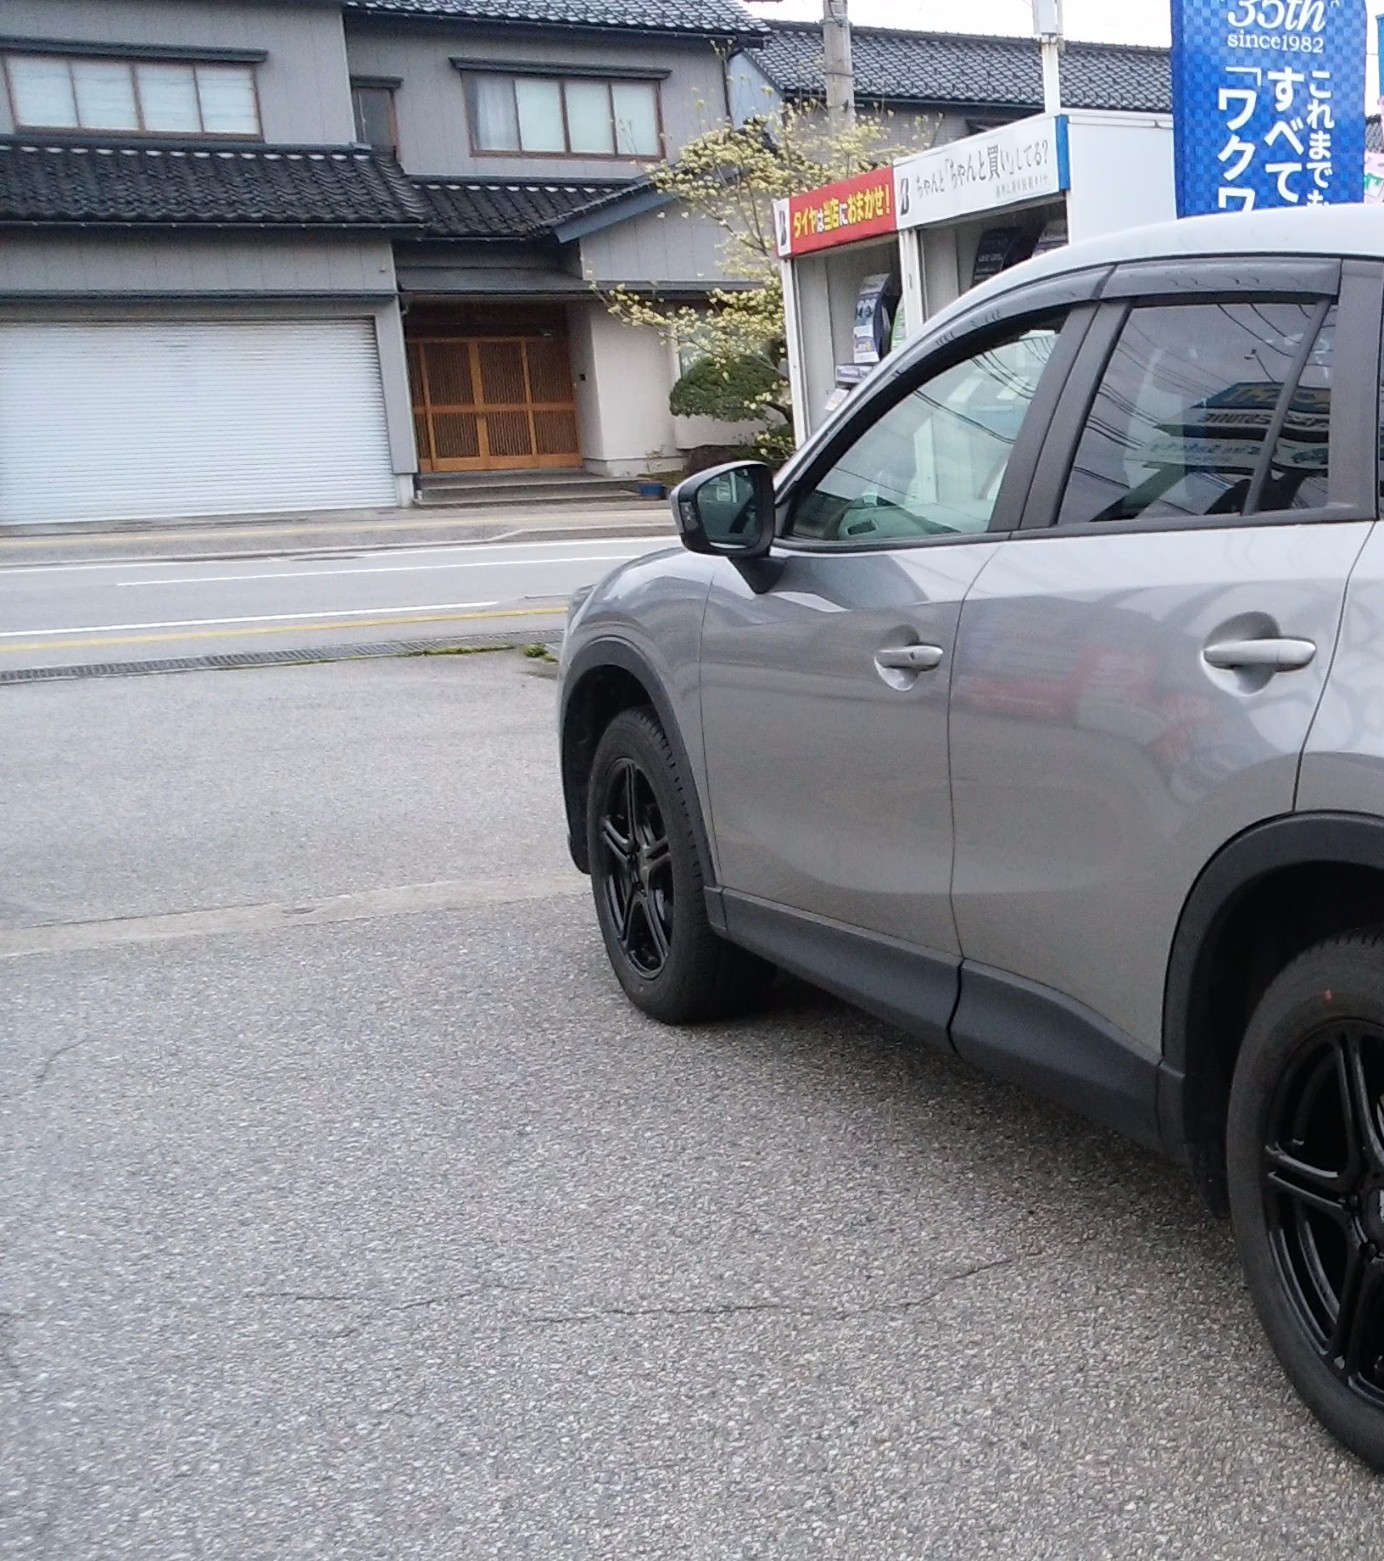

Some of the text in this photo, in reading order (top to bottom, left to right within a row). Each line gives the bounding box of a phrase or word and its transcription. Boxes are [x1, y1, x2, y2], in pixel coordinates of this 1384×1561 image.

[1227, 31, 1324, 53] since1982
[1263, 67, 1305, 203] すべて
